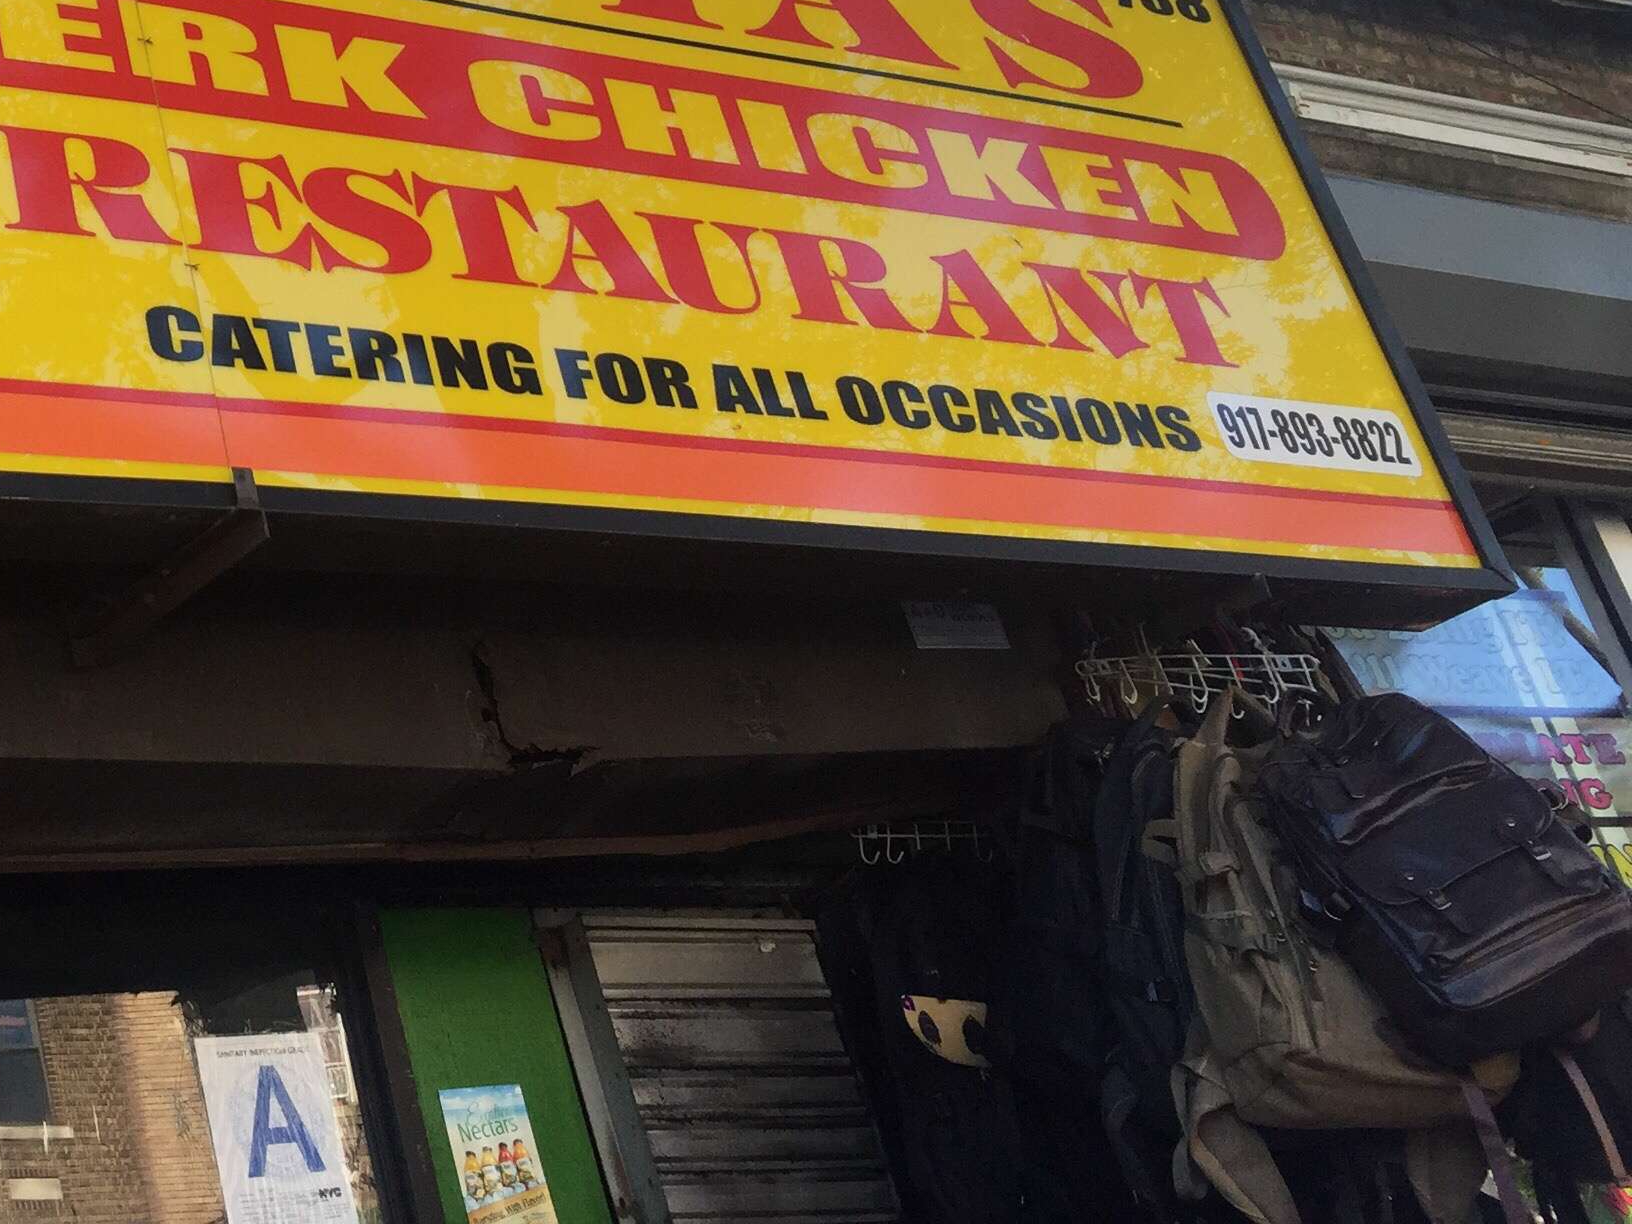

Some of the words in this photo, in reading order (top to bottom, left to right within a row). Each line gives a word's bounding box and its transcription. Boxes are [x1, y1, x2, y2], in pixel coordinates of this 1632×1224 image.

[466, 56, 1241, 238] CHICKEN
[143, 304, 542, 396] CATERING
[554, 347, 698, 410] FOR
[712, 363, 829, 423] ALL
[843, 375, 1202, 453] OCCASIONS
[1216, 402, 1413, 465] 917-893-8822
[248, 1064, 327, 1178] A
[457, 1116, 519, 1144] Nectars
